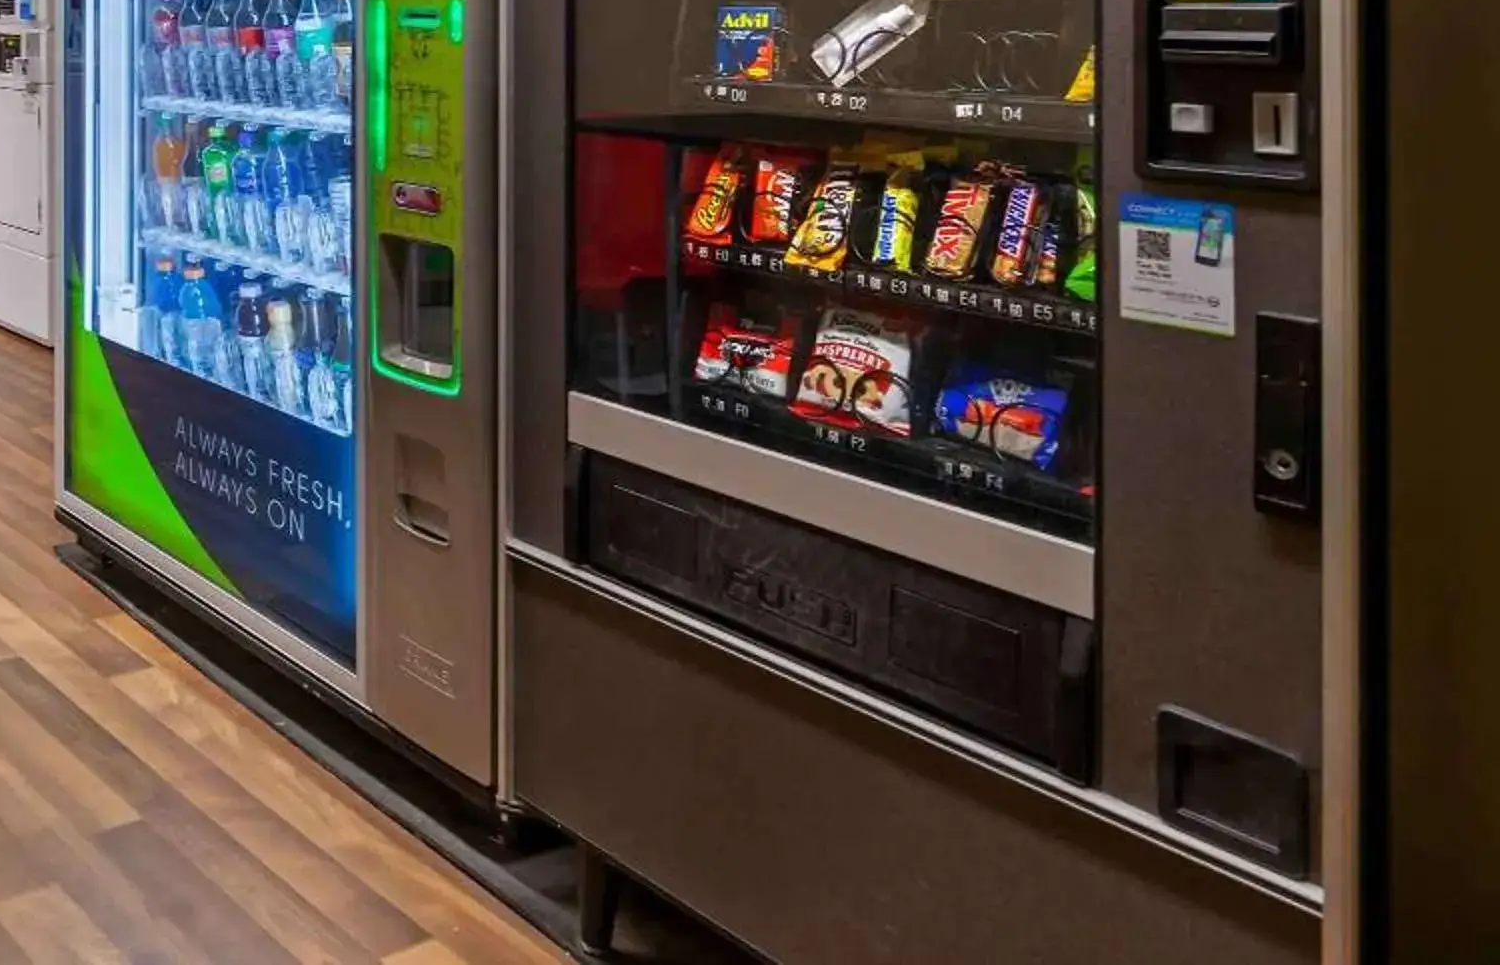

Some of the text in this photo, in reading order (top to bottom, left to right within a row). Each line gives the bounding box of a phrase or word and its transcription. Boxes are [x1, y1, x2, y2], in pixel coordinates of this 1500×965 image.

[721, 11, 770, 29] Advil
[849, 95, 868, 112] D2
[1002, 106, 1023, 123] D4
[931, 184, 979, 260] TWIX
[715, 248, 729, 263] E0
[768, 256, 784, 272] E1
[891, 278, 908, 295] E3
[959, 290, 977, 307] E4
[1033, 303, 1053, 320] E5
[814, 342, 888, 371] RASPBERRY
[735, 402, 750, 418] F0
[174, 415, 258, 477] ALWAYS
[850, 434, 867, 453] F2
[986, 472, 1004, 491] F4
[174, 451, 306, 542] ALWAYS ON
